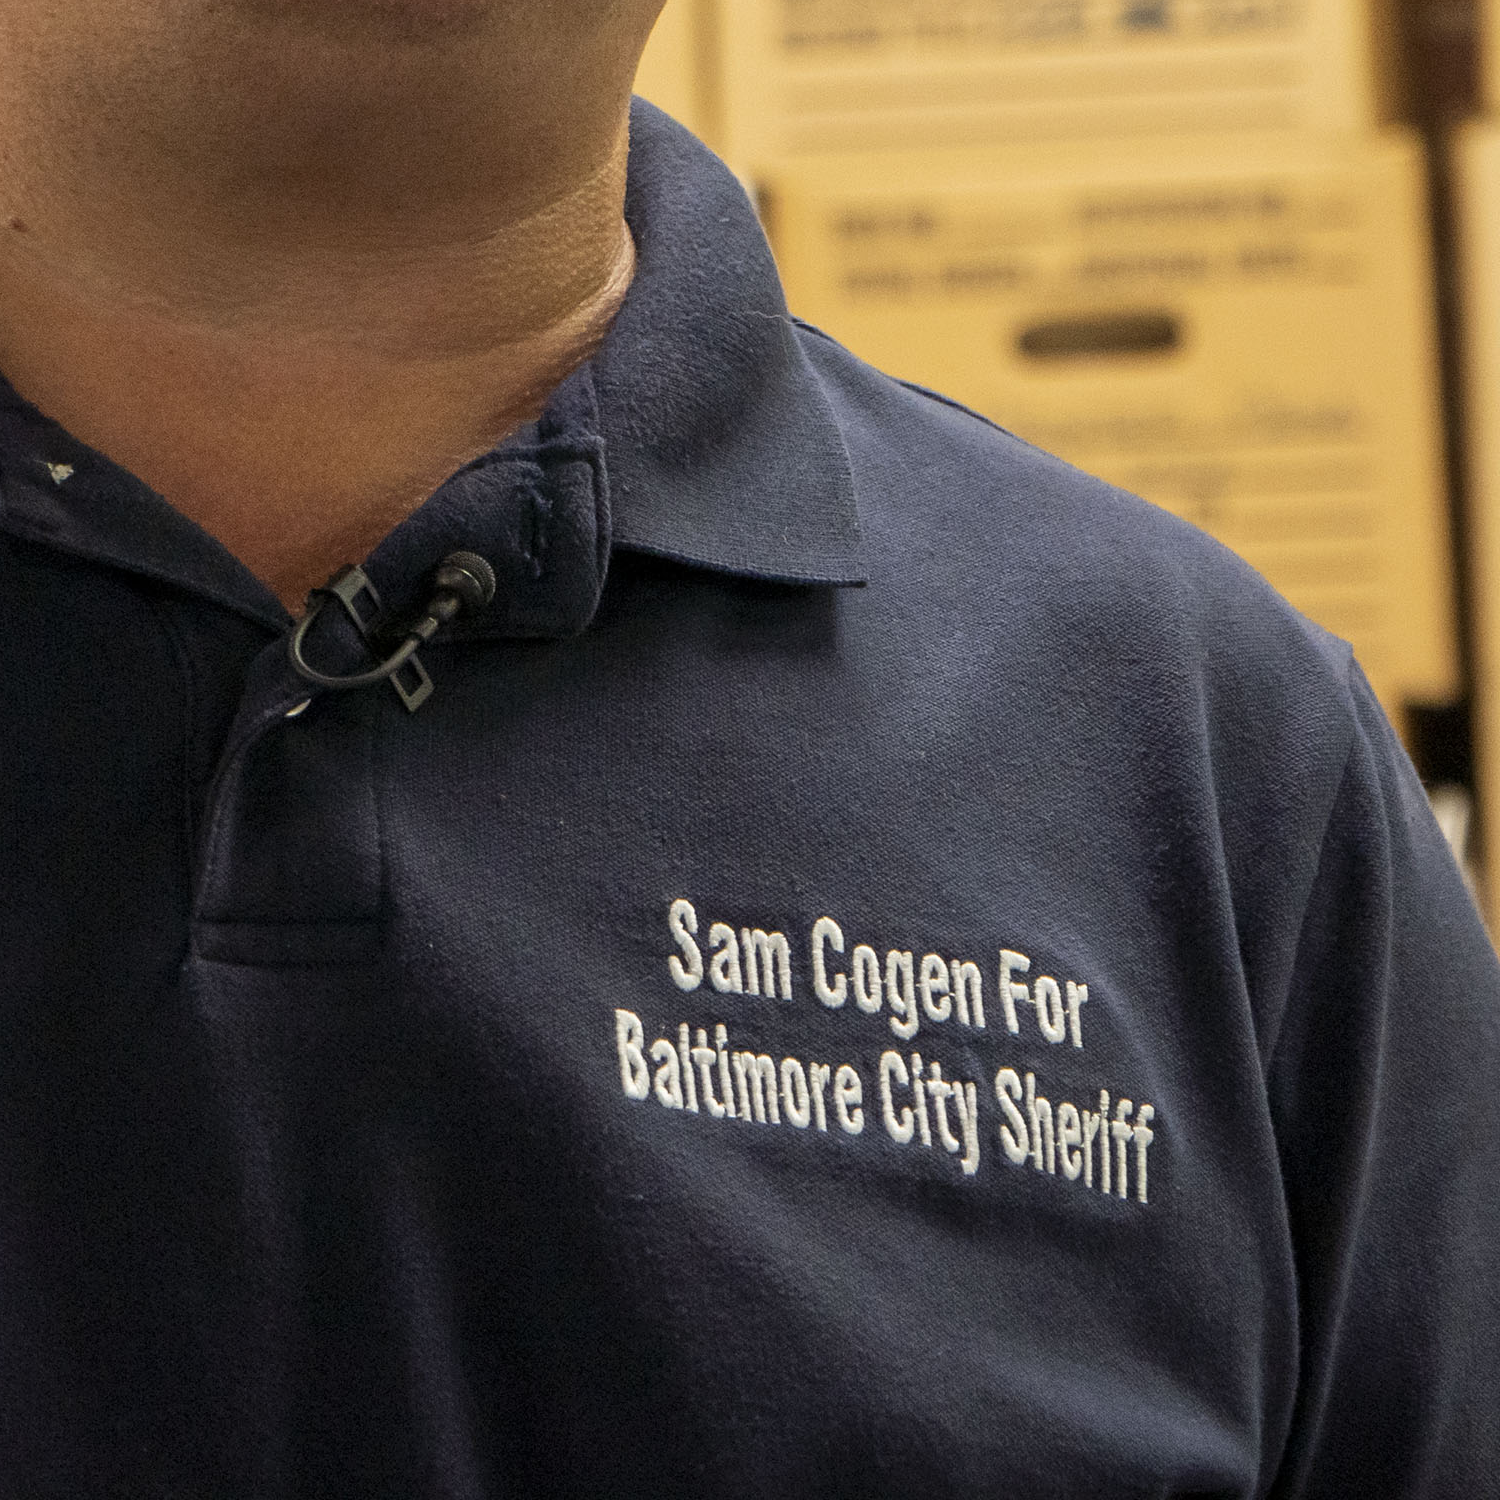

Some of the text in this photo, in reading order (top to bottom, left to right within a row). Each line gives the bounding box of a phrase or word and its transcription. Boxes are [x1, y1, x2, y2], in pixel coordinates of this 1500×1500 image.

[668, 898, 1089, 1049] Sam Cogen For
[614, 1008, 1155, 1204] Baltimore City Sheriff
